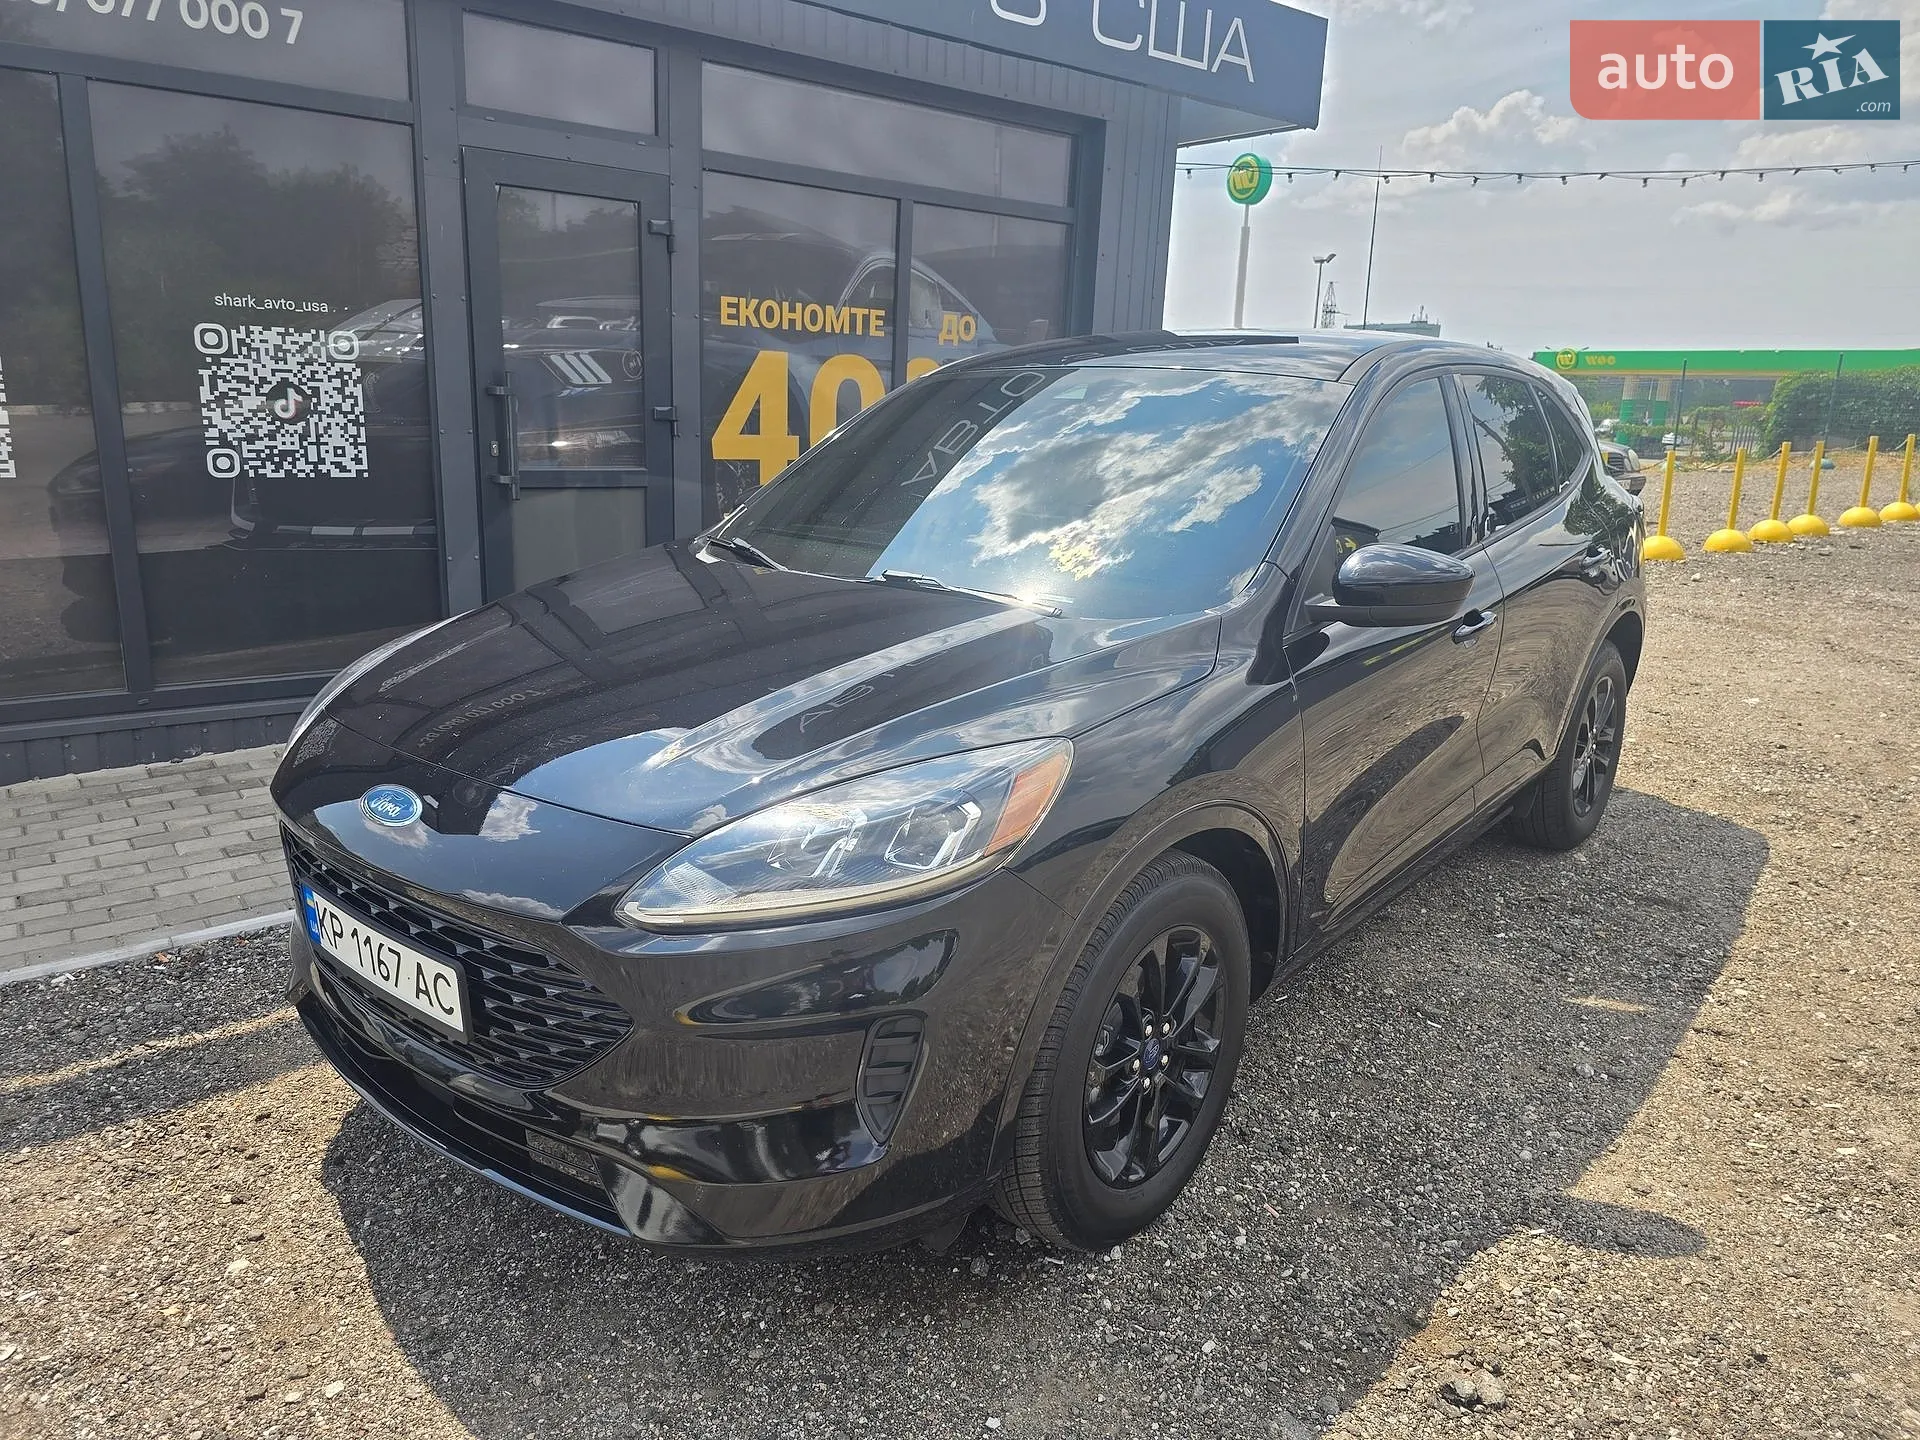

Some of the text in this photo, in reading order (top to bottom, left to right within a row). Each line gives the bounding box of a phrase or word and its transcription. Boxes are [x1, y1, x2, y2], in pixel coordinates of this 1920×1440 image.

[179, 0, 270, 40] 000
[280, 7, 304, 45] 7
[1092, 0, 1255, 83] США
[214, 292, 329, 313] shark_avto_usa
[719, 295, 976, 346] ЕКОНОМТЕ ДО
[351, 927, 402, 988] 1167
[415, 961, 455, 1016] AC
